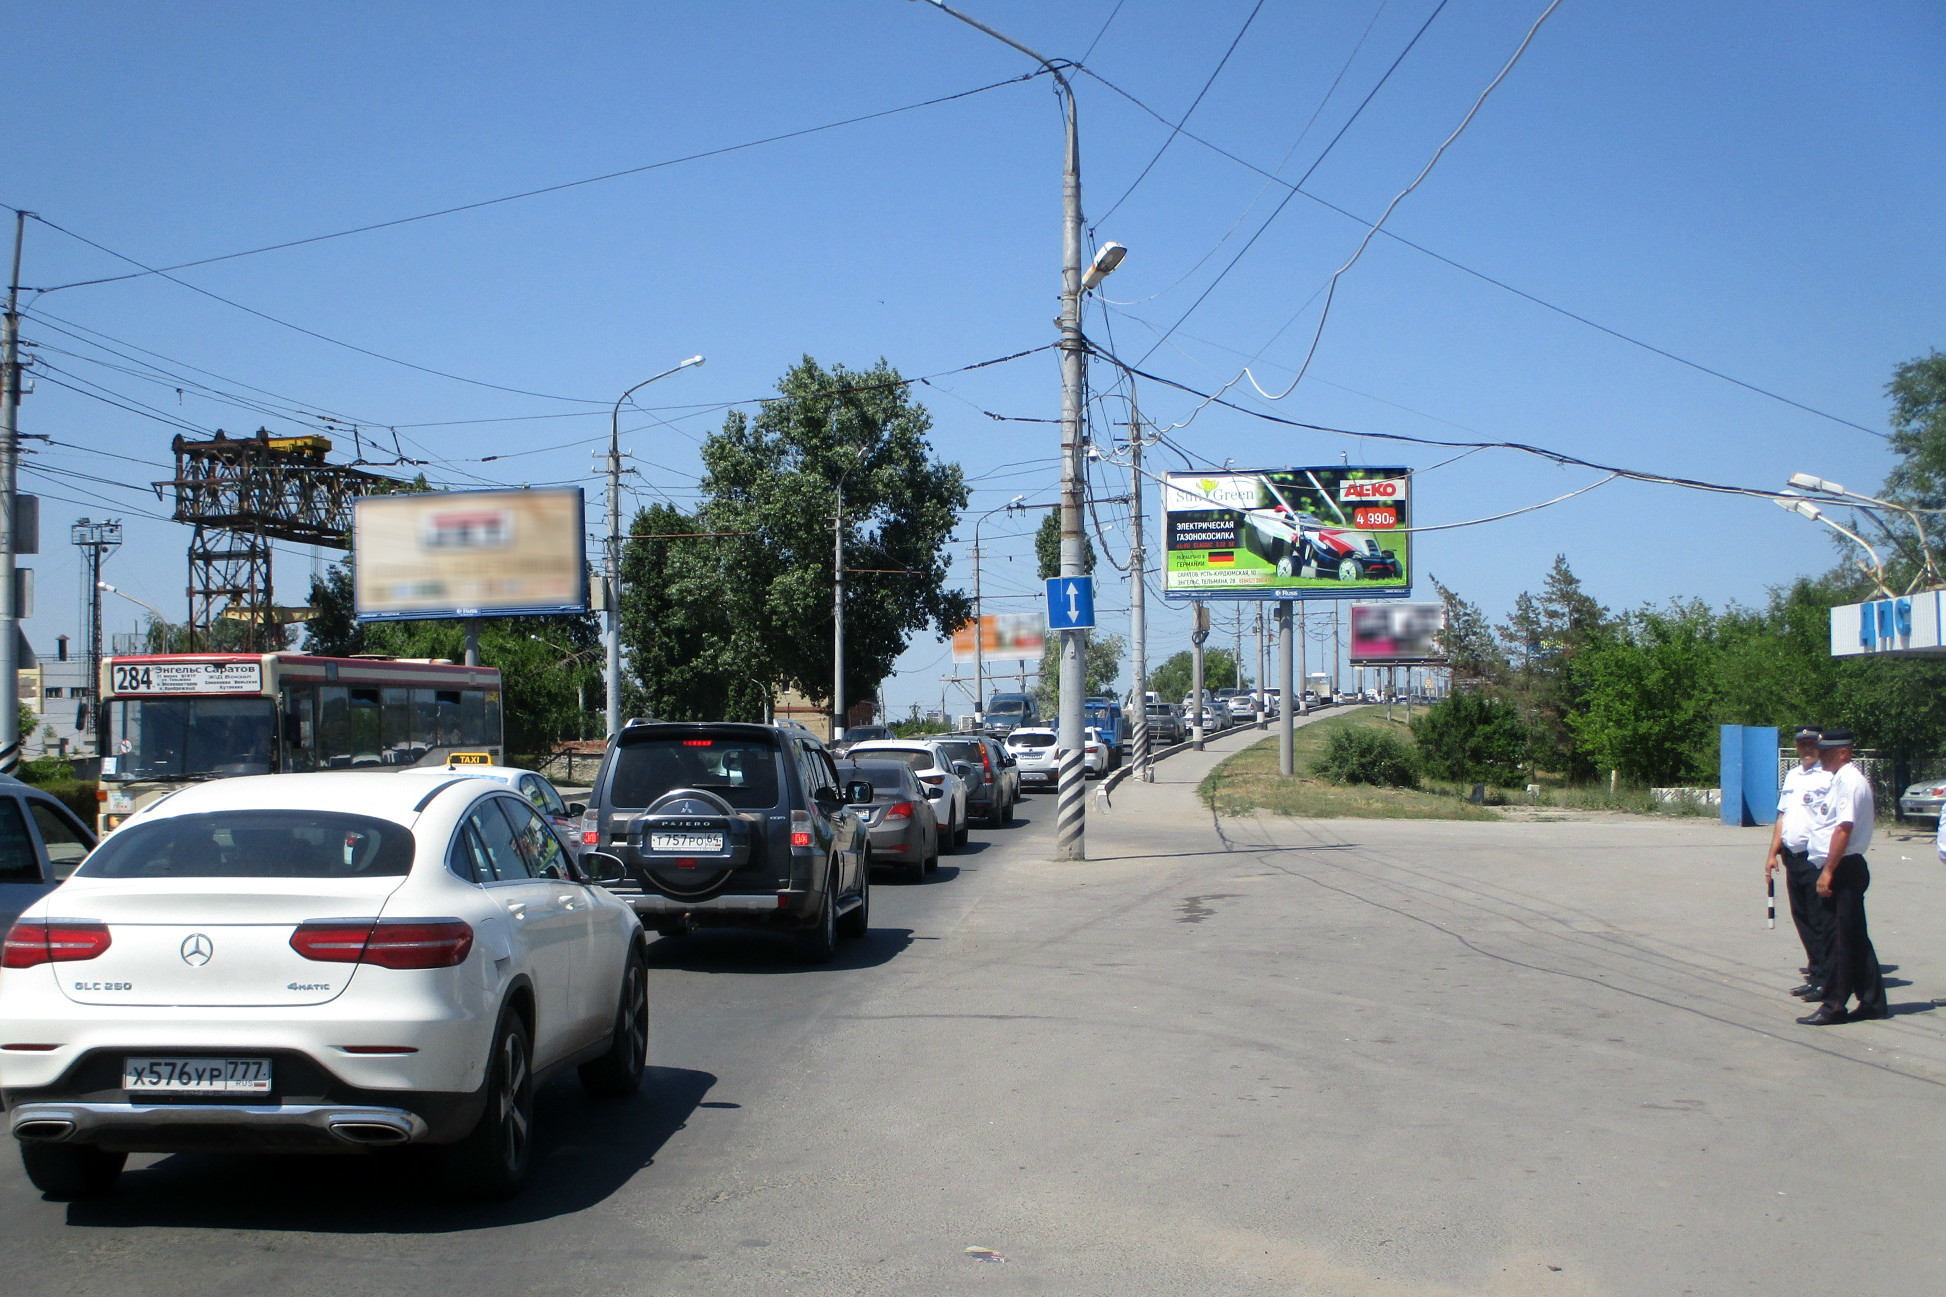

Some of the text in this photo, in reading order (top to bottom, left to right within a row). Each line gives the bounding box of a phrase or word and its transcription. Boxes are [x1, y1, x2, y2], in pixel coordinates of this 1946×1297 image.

[1344, 483, 1396, 497] AL-KO
[1176, 489, 1254, 503] Sun Green
[1356, 513, 1364, 524] 4
[1176, 520, 1235, 531] ЭЛЕКТРИЧЕСКАЯ
[1176, 531, 1235, 541] ГАЗОНОКОСИЛКА
[155, 665, 256, 674] Энгельс Саратов
[116, 666, 153, 691] 284
[459, 756, 480, 764] TAXI
[707, 834, 719, 844] 64
[75, 982, 132, 990] GLC 250
[287, 982, 330, 990] 4MATIC
[228, 1061, 263, 1080] 777
[235, 1079, 254, 1087] RUS
